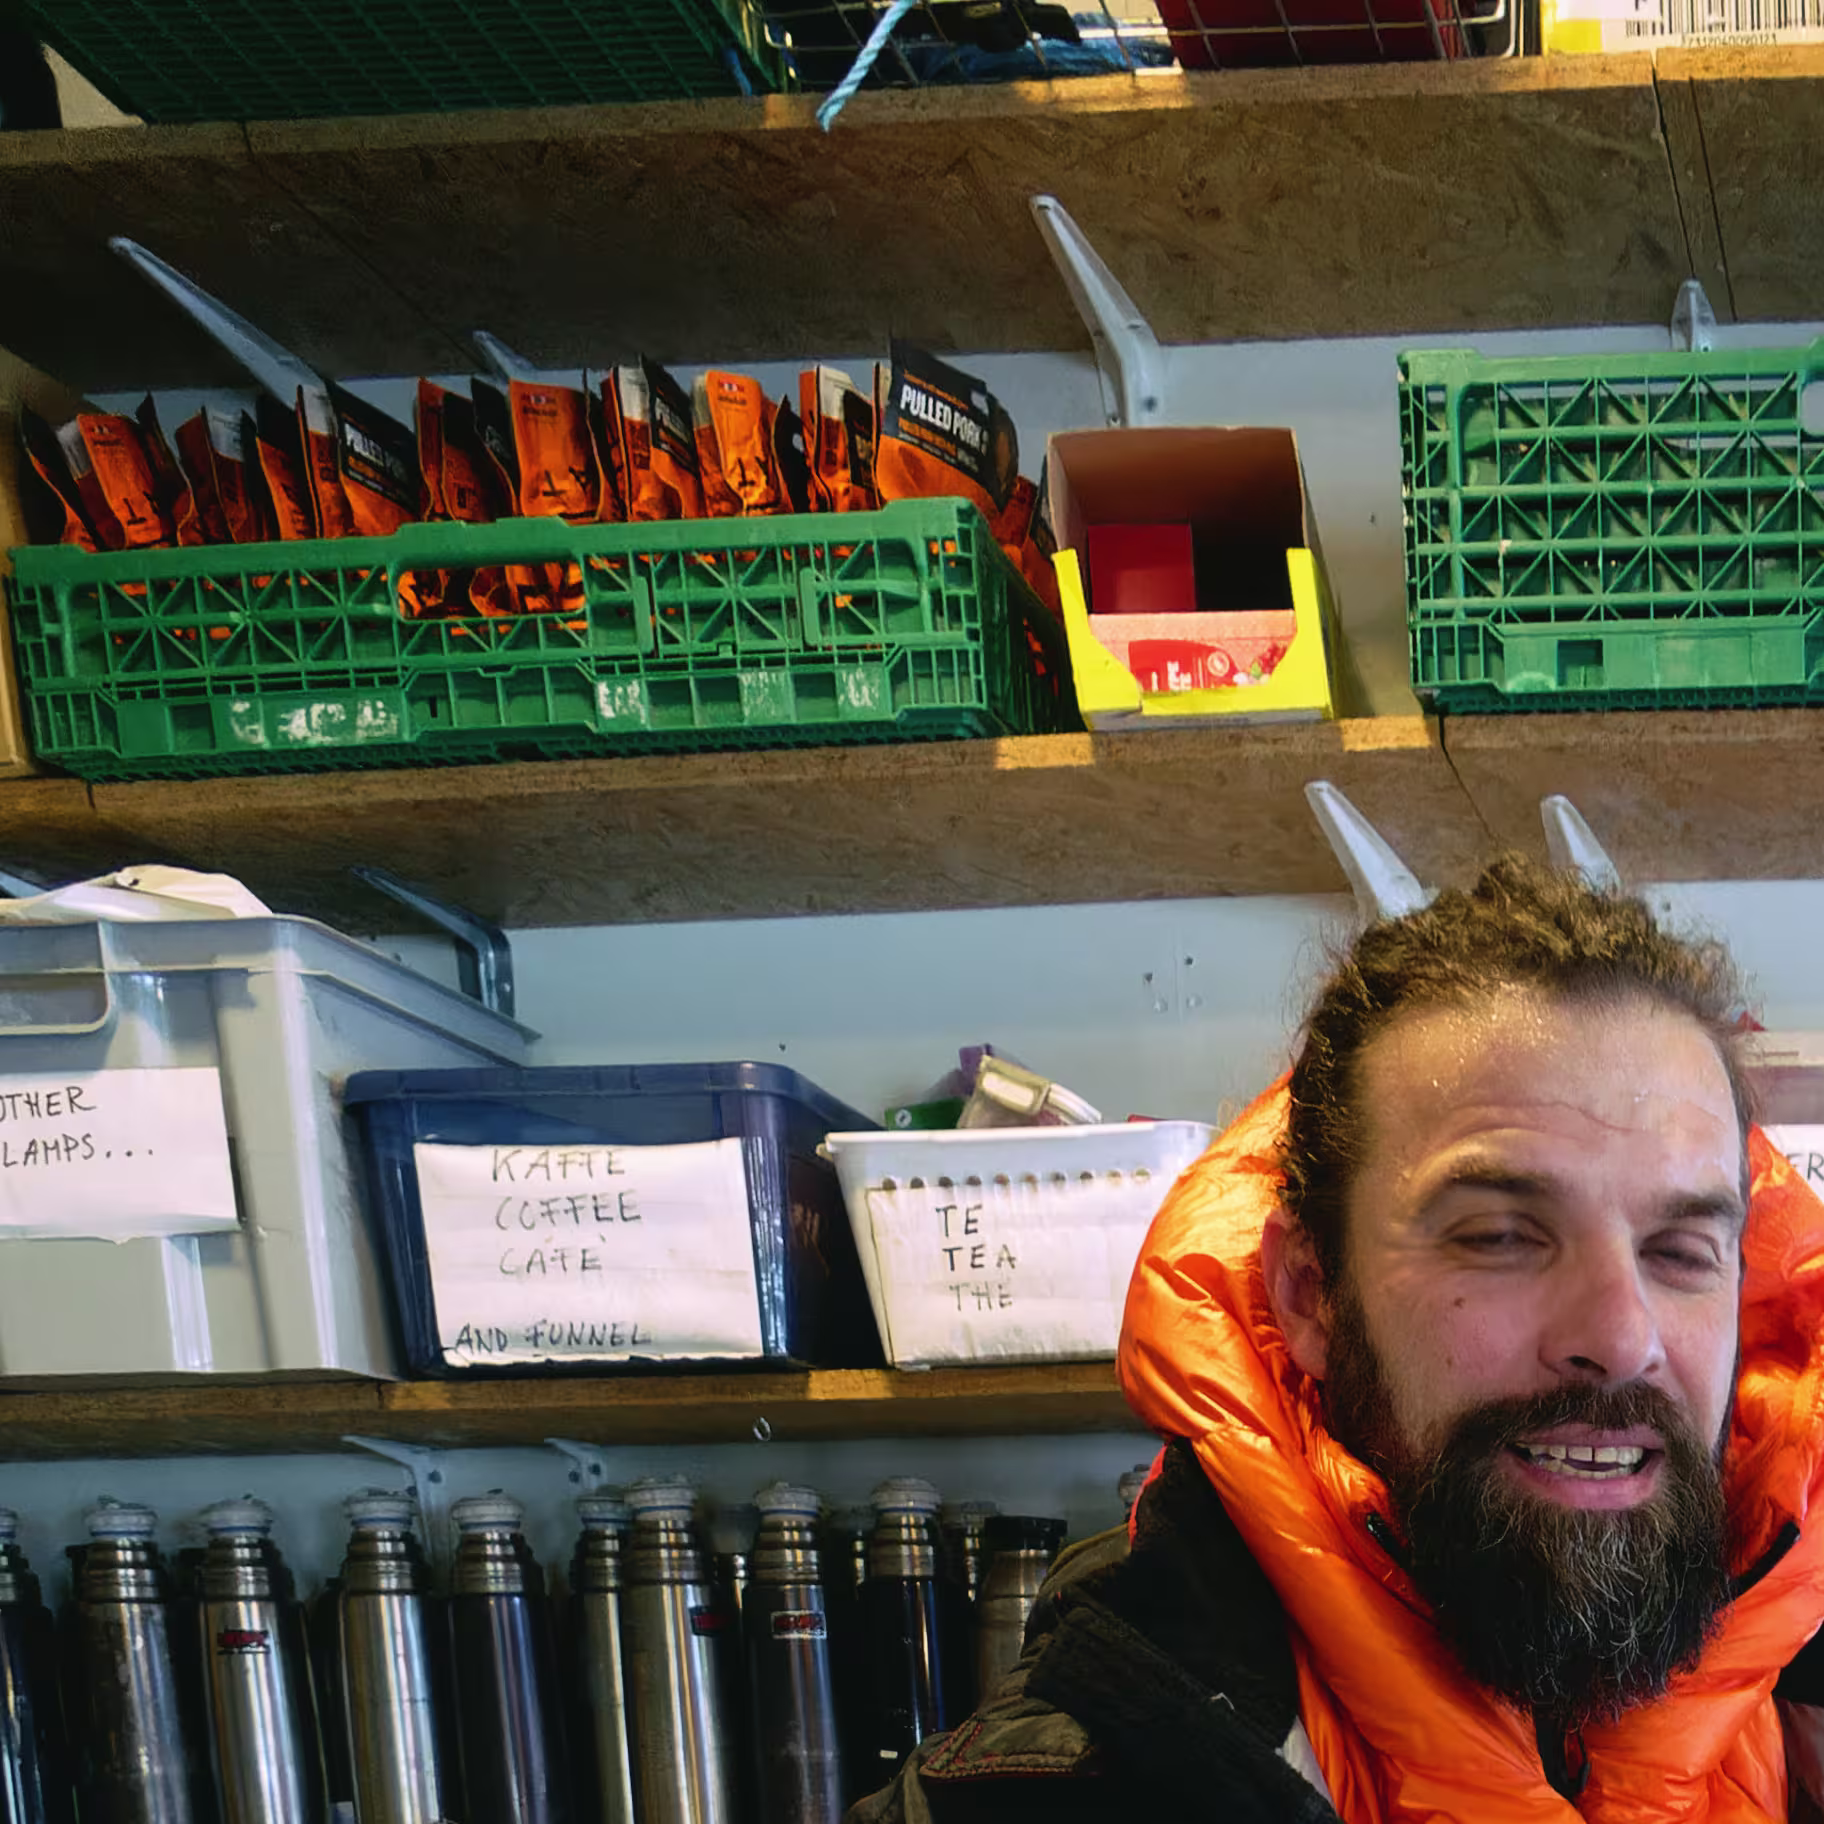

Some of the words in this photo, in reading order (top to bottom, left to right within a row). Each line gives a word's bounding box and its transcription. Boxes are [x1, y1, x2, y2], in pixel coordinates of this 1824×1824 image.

[900, 384, 952, 432] PULLED
[495, 1190, 641, 1231] COFFEE
[935, 1204, 982, 1238] TE
[942, 1244, 1017, 1272] TEA
[454, 1323, 508, 1353] AND
[524, 1319, 652, 1348] FUNNEL
